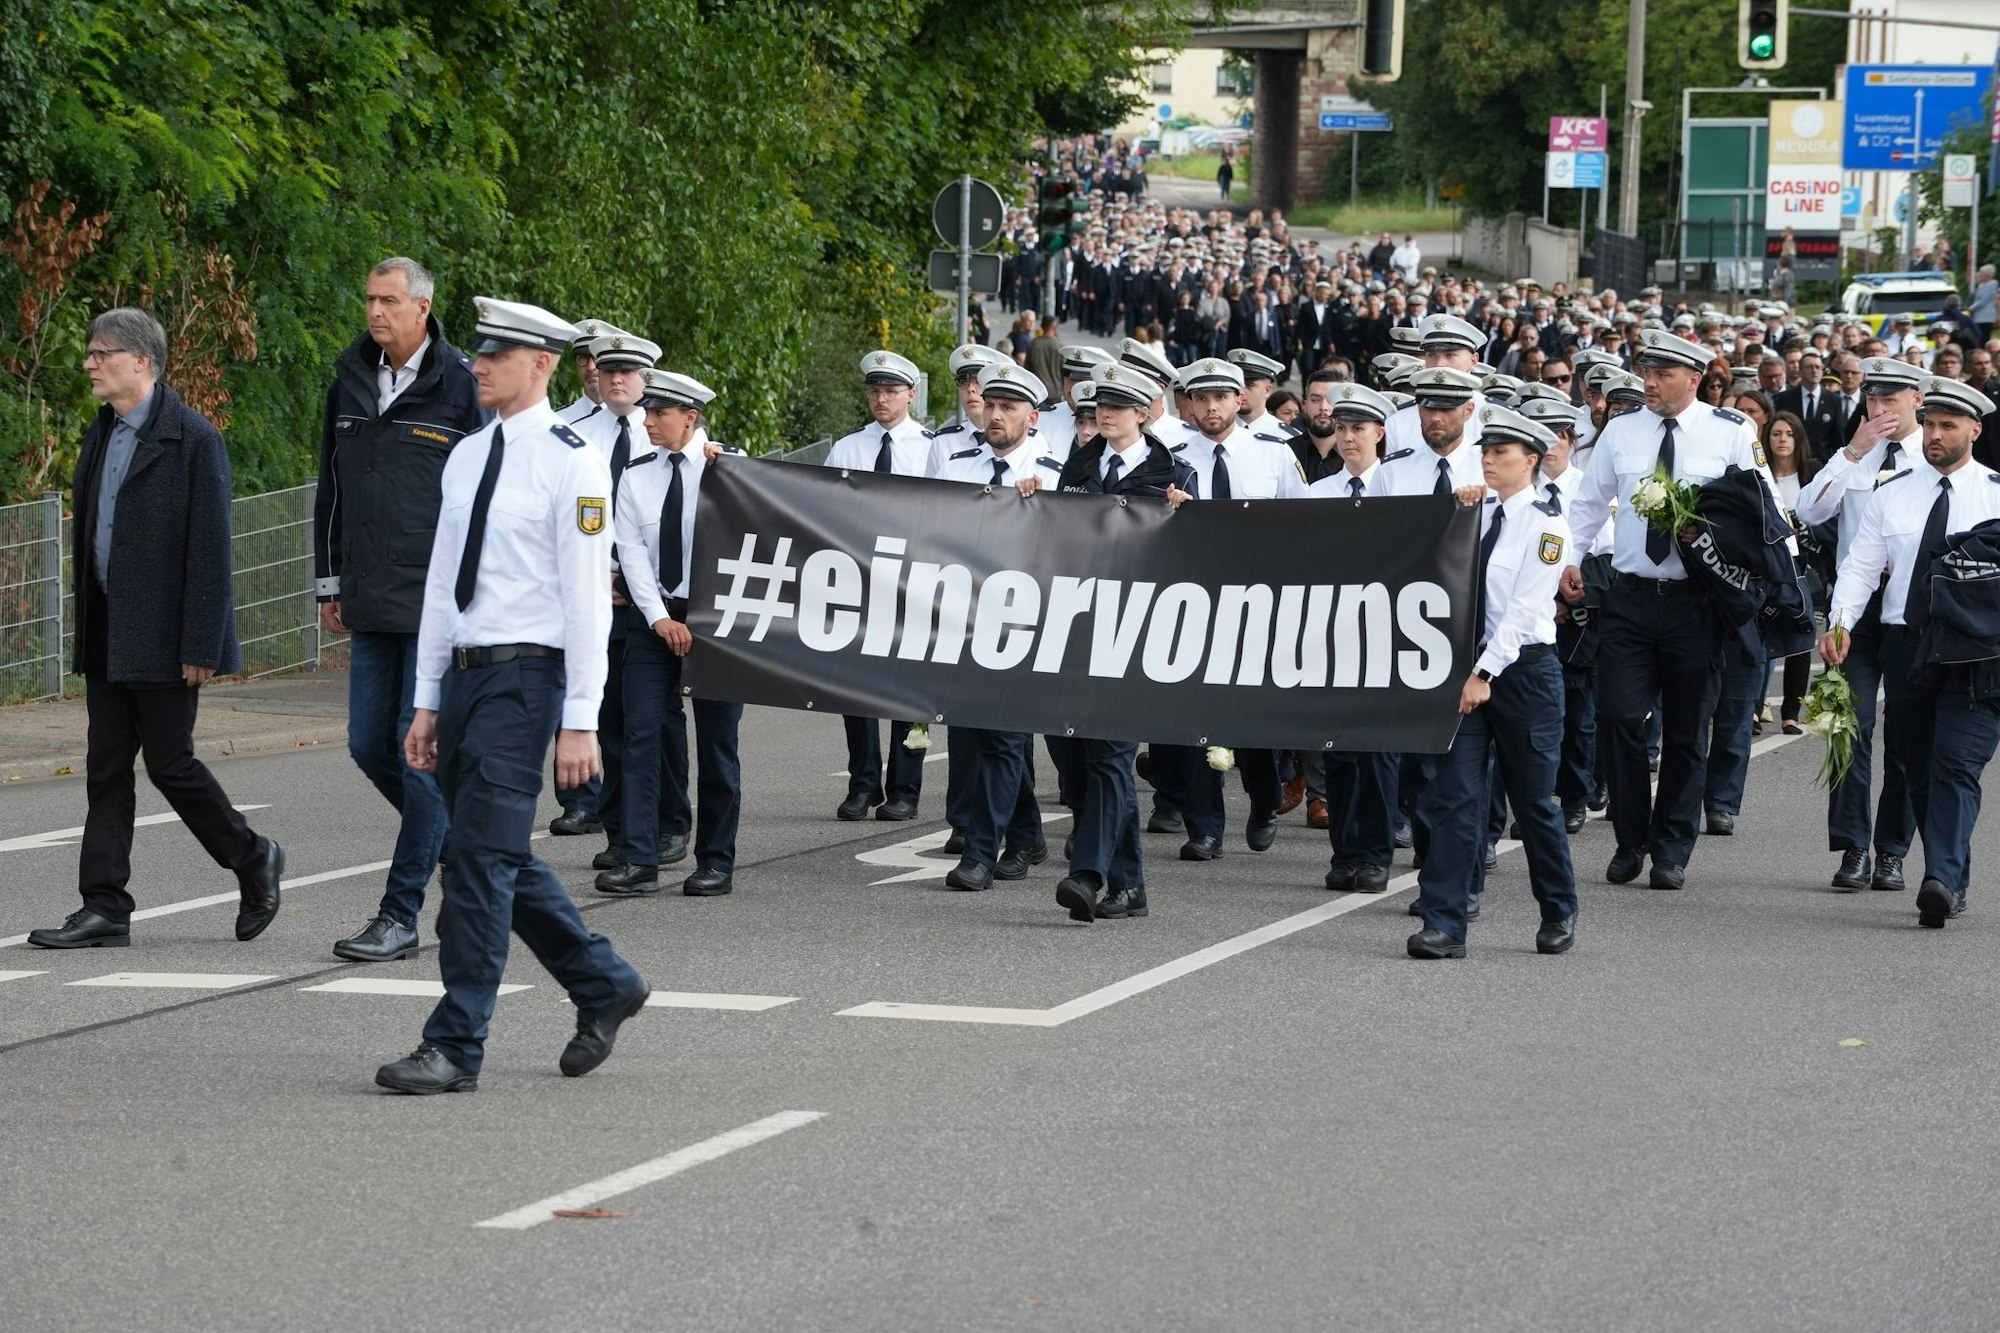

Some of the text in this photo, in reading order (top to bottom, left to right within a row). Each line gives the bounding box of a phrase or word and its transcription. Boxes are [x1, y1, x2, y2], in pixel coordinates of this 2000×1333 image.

[1854, 114, 1911, 125] Luxembourg
[1558, 118, 1599, 136] KFC
[1854, 124, 1911, 133] Neunkirchen
[1775, 140, 1840, 154] MEDUSA
[714, 532, 1453, 690] #einervonuns
